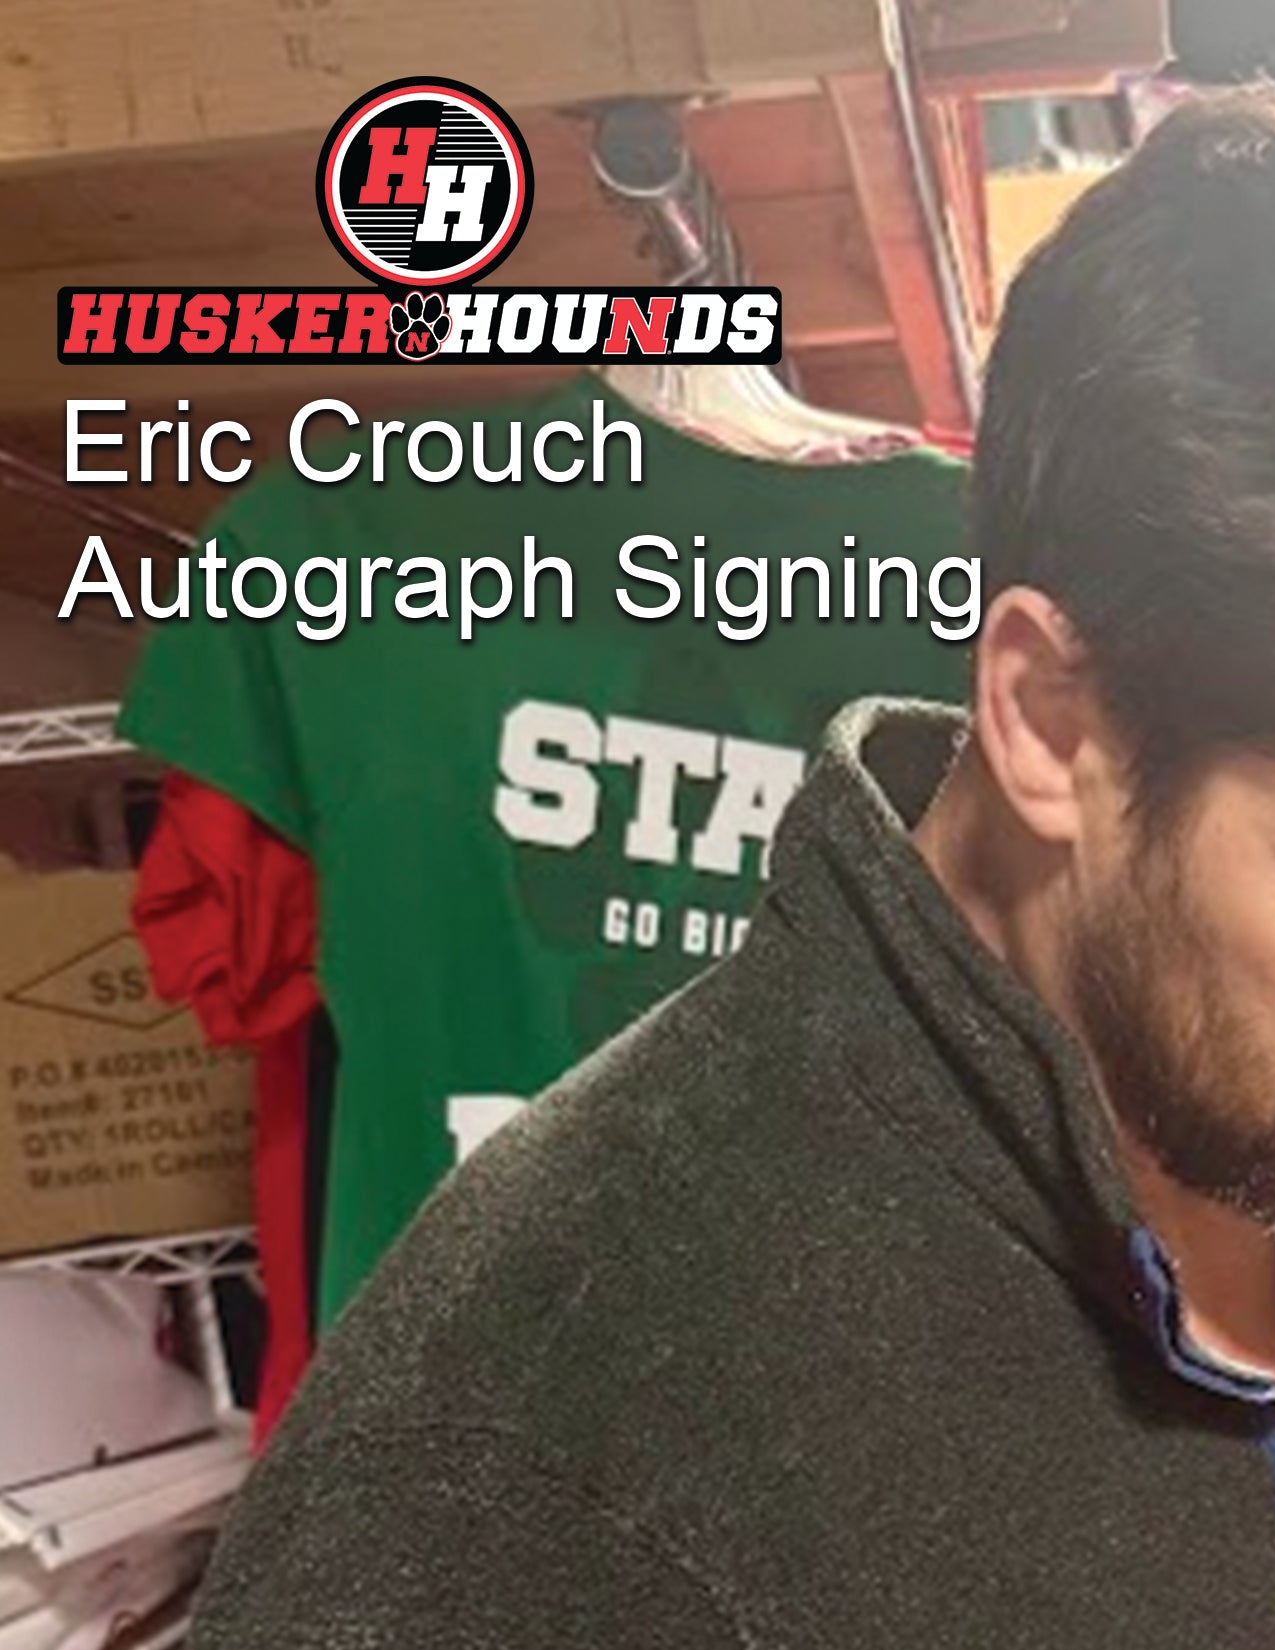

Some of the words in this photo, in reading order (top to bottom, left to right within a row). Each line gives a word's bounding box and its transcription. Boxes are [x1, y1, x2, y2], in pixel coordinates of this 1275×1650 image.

[604, 898, 660, 948] GO
[28, 1160, 108, 1188] Made
[116, 1157, 145, 1180] in
